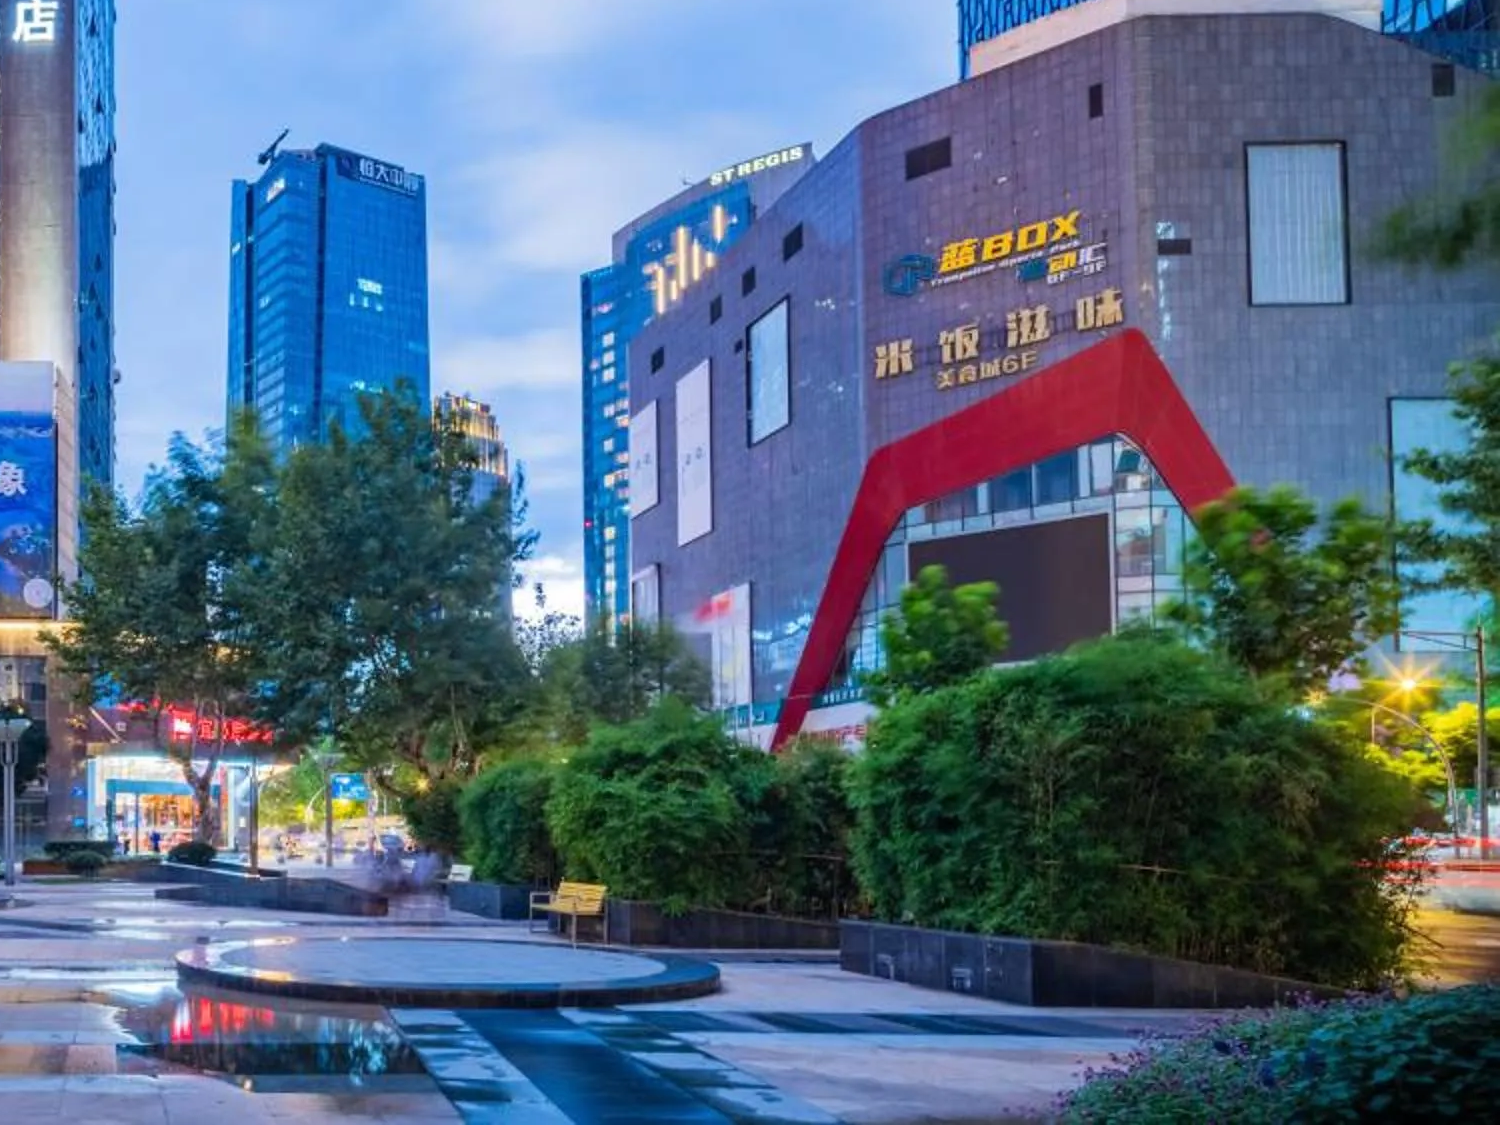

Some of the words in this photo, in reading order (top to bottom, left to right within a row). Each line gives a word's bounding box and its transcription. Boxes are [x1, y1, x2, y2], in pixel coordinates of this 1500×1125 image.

[737, 146, 803, 176] REGIS
[875, 287, 1124, 379] 米饭滋味
